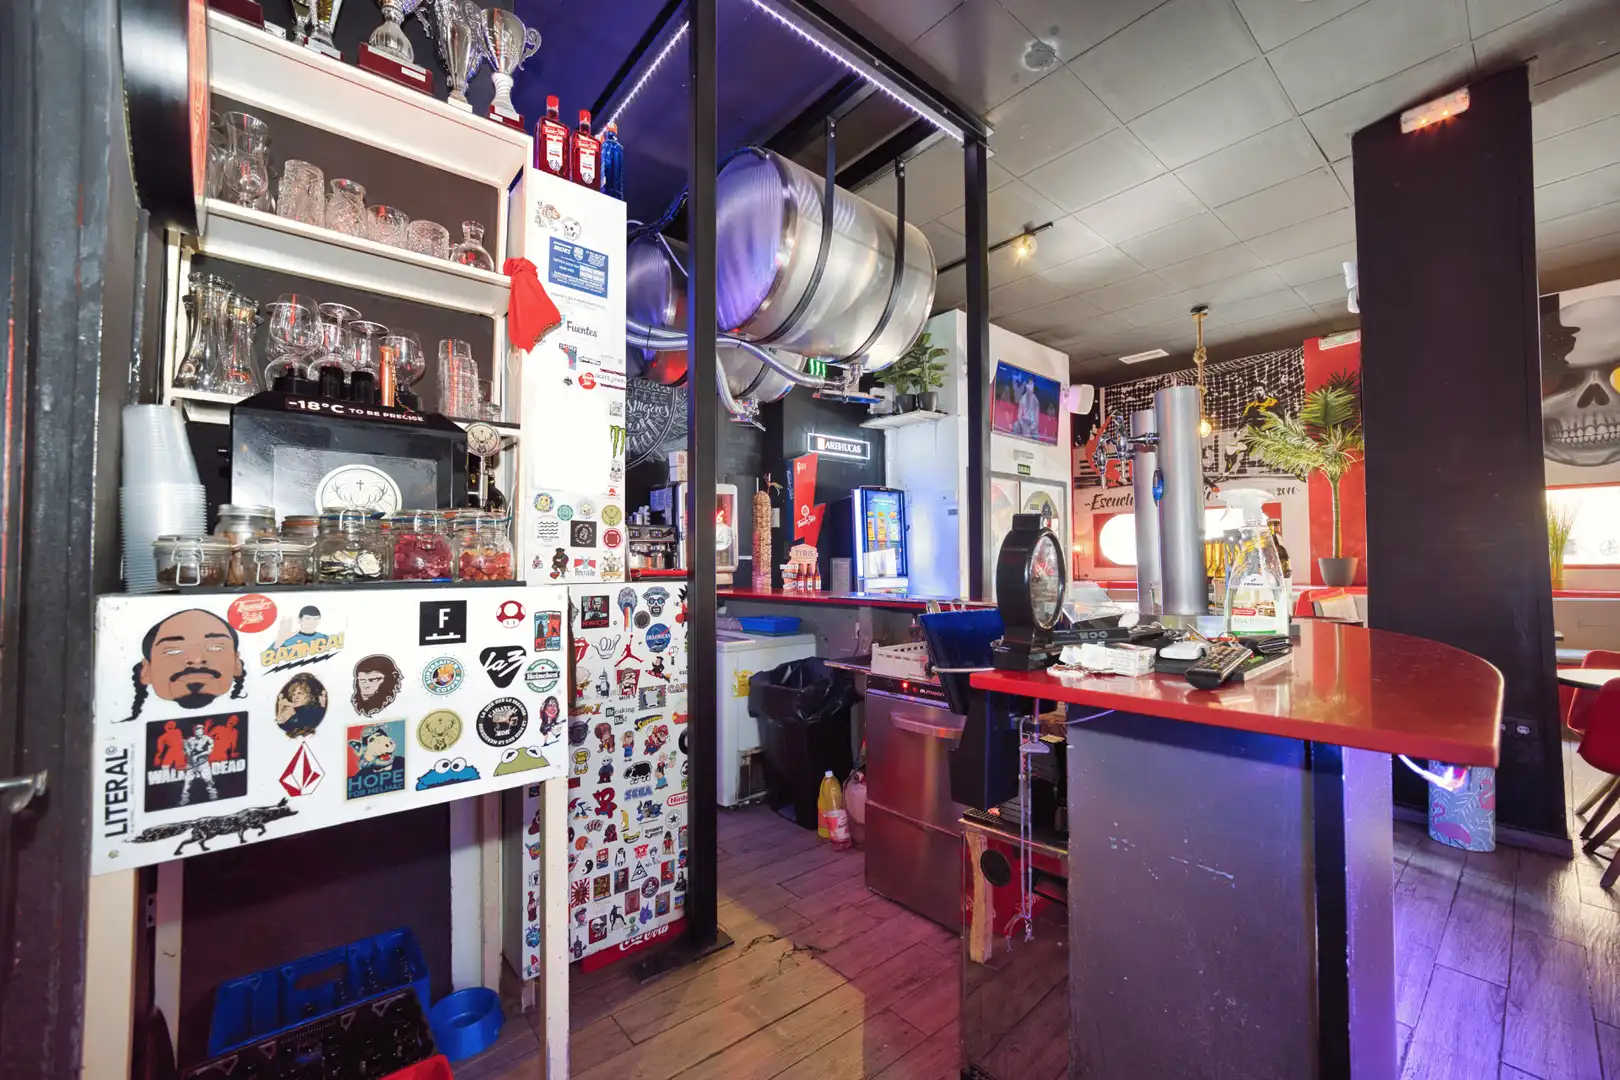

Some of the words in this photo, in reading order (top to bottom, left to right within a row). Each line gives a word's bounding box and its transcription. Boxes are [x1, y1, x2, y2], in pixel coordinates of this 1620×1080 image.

[566, 320, 598, 338] Fuentes
[348, 407, 364, 416] TO
[382, 412, 425, 422] PRECISE
[825, 440, 862, 454] AREHUCAS
[438, 608, 451, 629] F
[260, 631, 345, 667] BAZINGA!
[527, 671, 559, 681] Heineken
[211, 758, 246, 776] DEAD
[348, 770, 404, 791] HOPE
[347, 789, 366, 799] FOR
[367, 782, 404, 795] MELMAC
